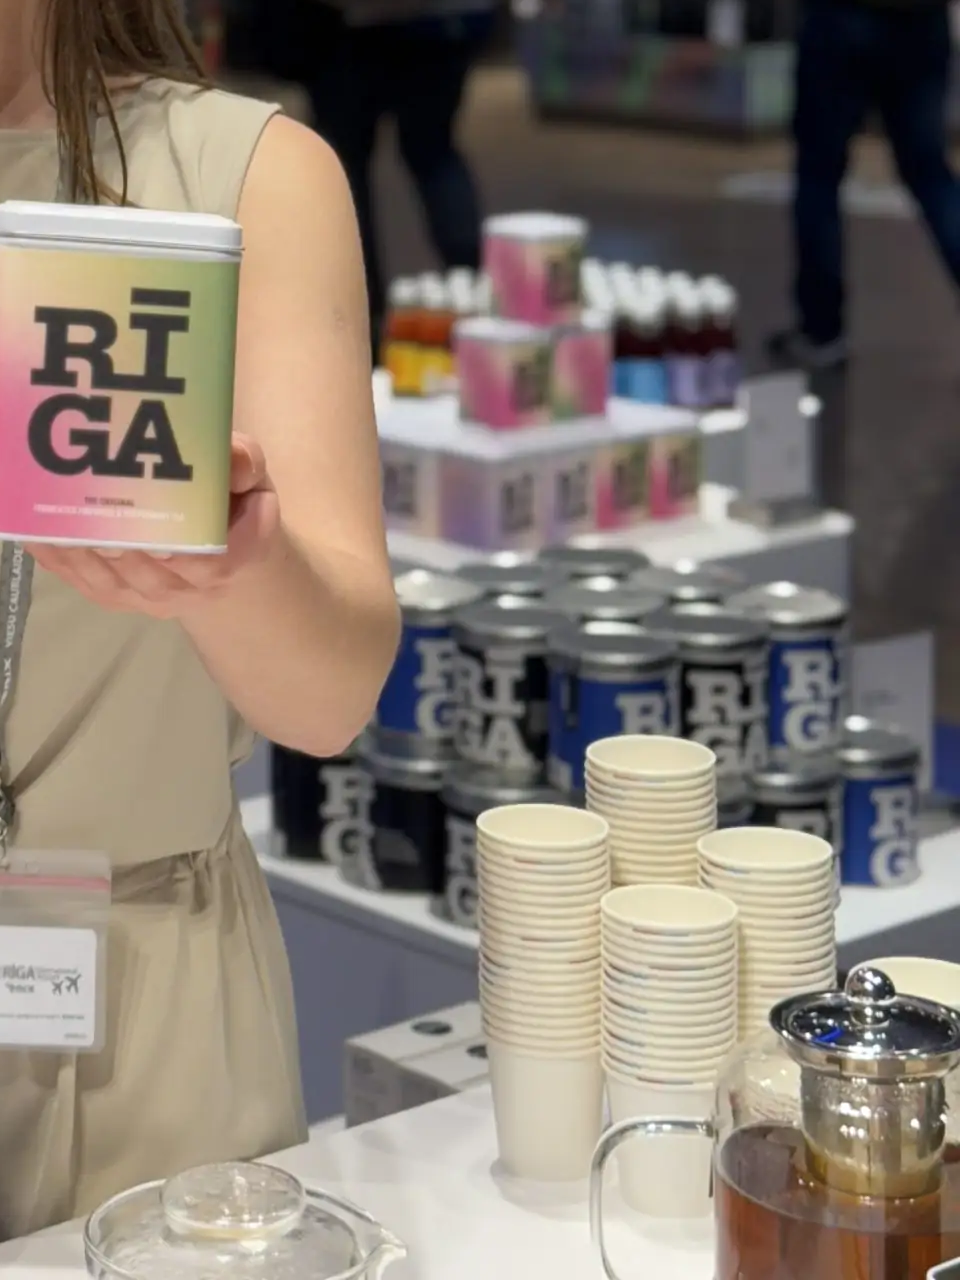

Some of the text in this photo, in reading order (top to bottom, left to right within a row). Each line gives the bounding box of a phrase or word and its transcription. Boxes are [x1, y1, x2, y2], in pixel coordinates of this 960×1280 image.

[30, 287, 192, 395] RĪ
[27, 393, 194, 482] GA
[5, 616, 17, 648] VIESU
